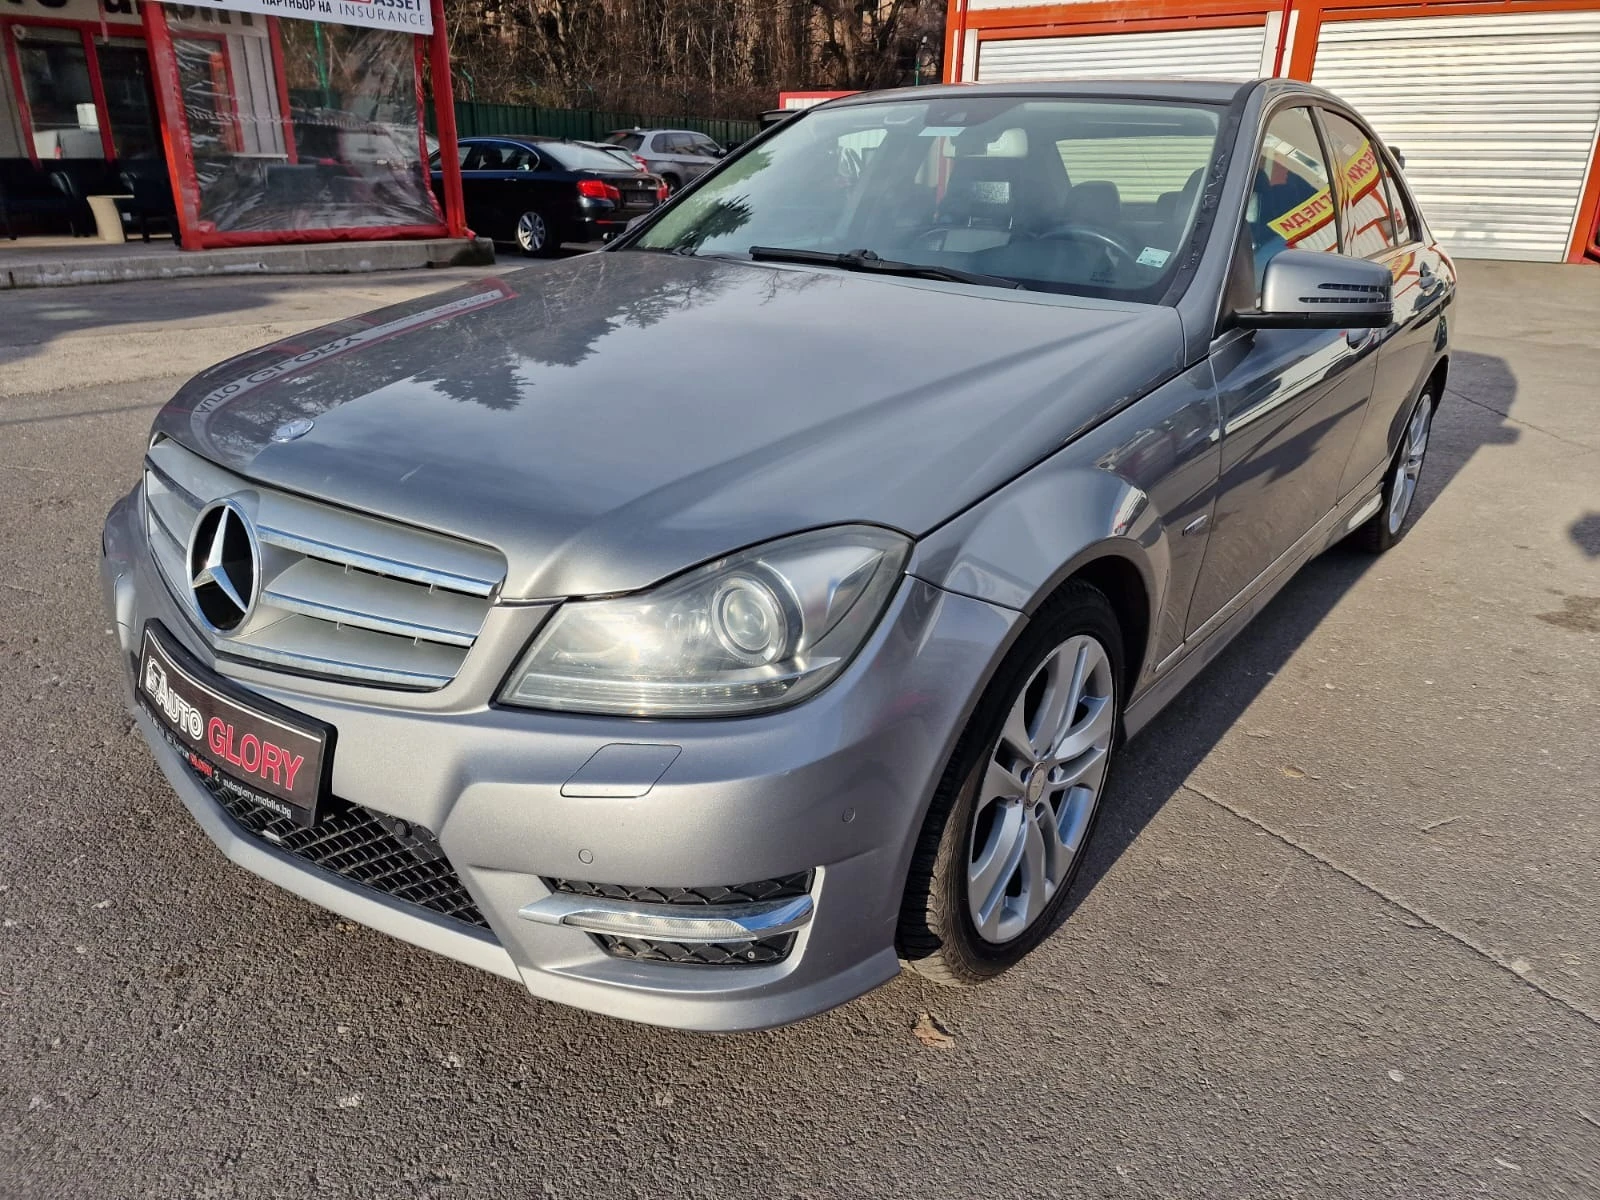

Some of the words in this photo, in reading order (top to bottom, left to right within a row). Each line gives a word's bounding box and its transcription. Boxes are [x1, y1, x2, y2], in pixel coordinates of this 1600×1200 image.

[318, 1, 332, 13] НА
[339, 3, 426, 26] INSURANCE
[156, 670, 204, 740] AUTO
[208, 717, 304, 791] GLORY
[223, 778, 292, 819] autoglory.mobile.bg
